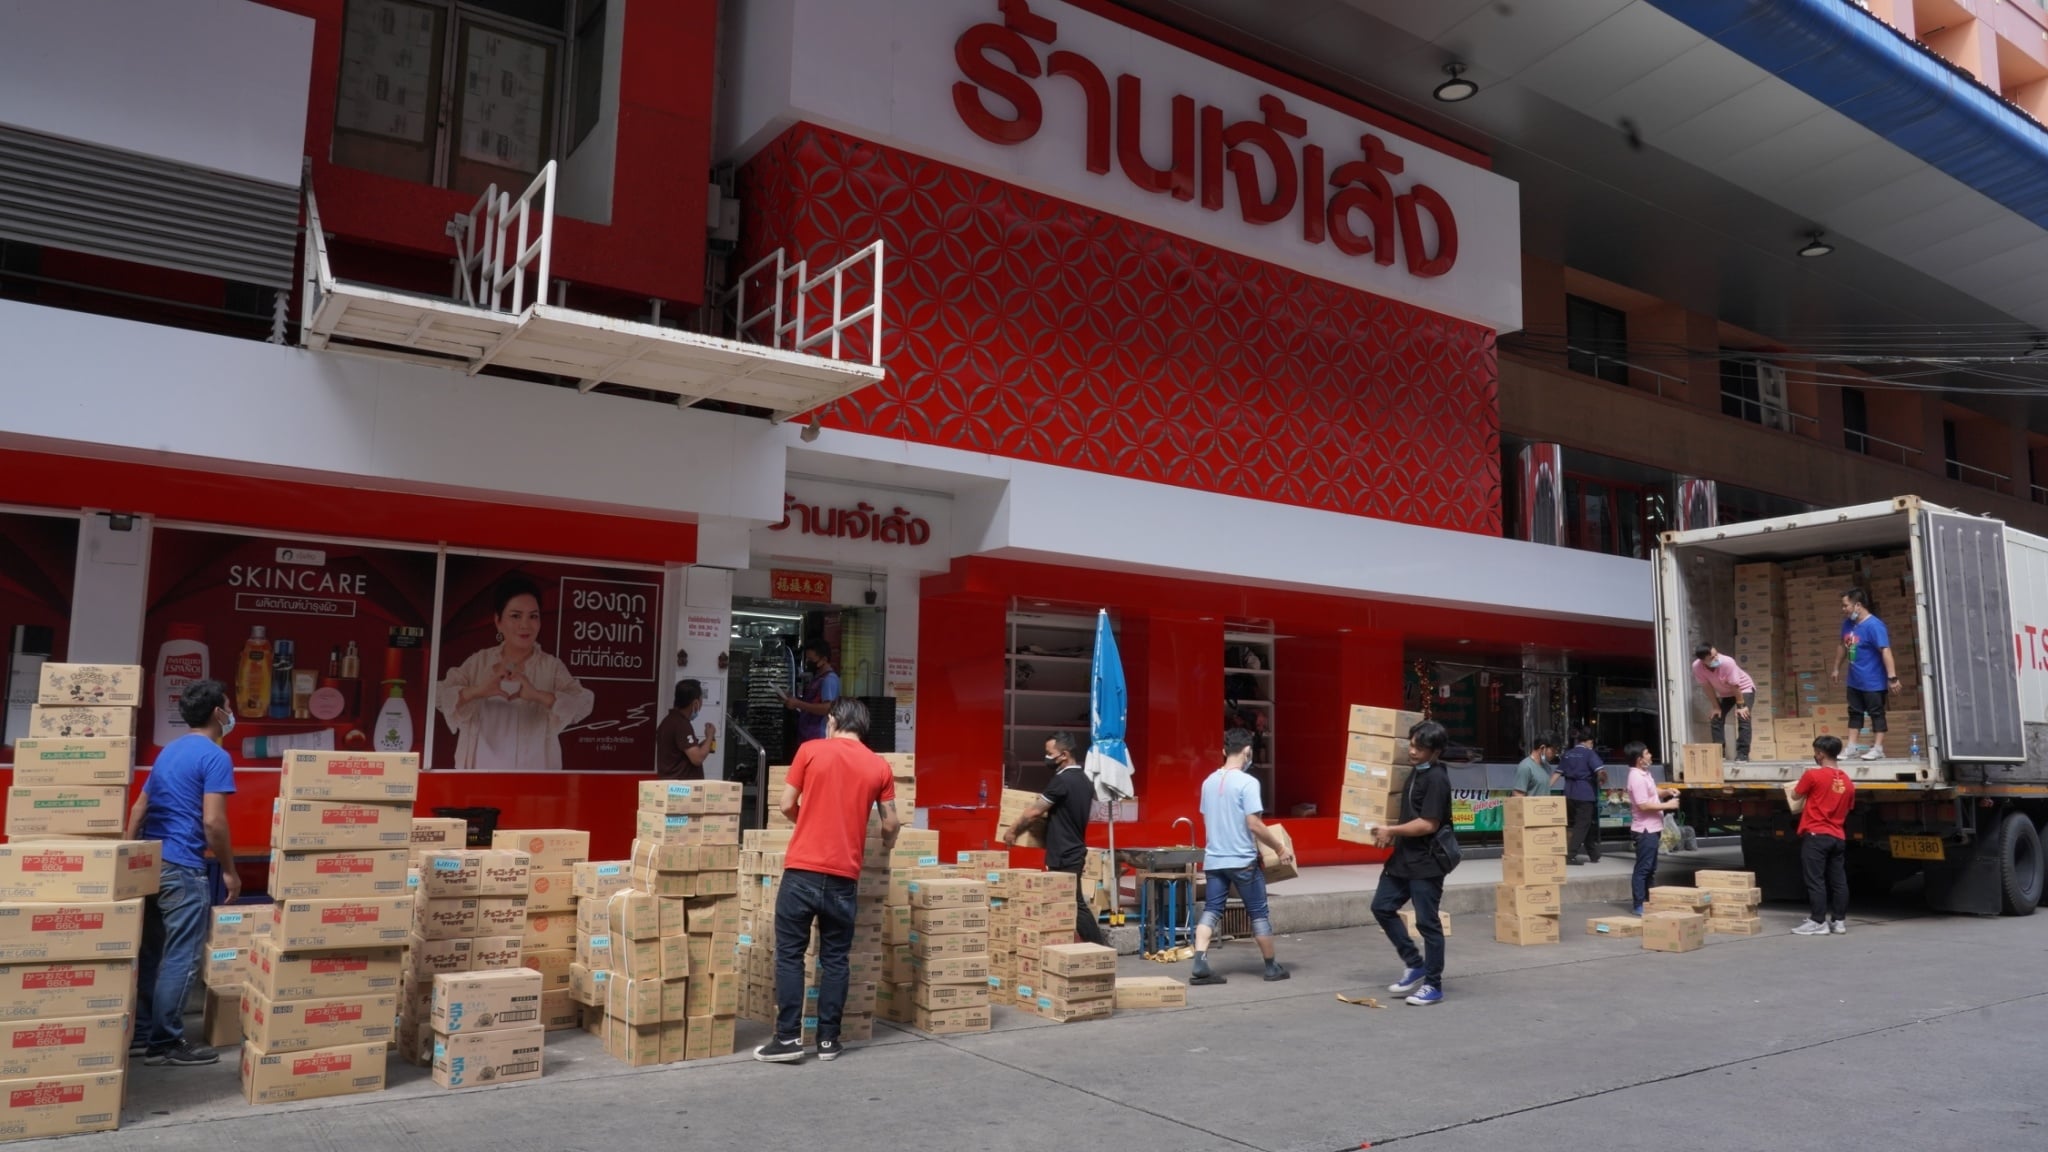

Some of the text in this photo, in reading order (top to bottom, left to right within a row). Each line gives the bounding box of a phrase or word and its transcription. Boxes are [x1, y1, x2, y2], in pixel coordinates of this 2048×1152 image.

[228, 565, 368, 595] SKINCARE
[573, 589, 647, 620] ของถูก
[573, 617, 645, 644] ของแท้
[570, 645, 643, 669] มีที่นี่ที่เดียว
[1893, 839, 1940, 854] 71-1380
